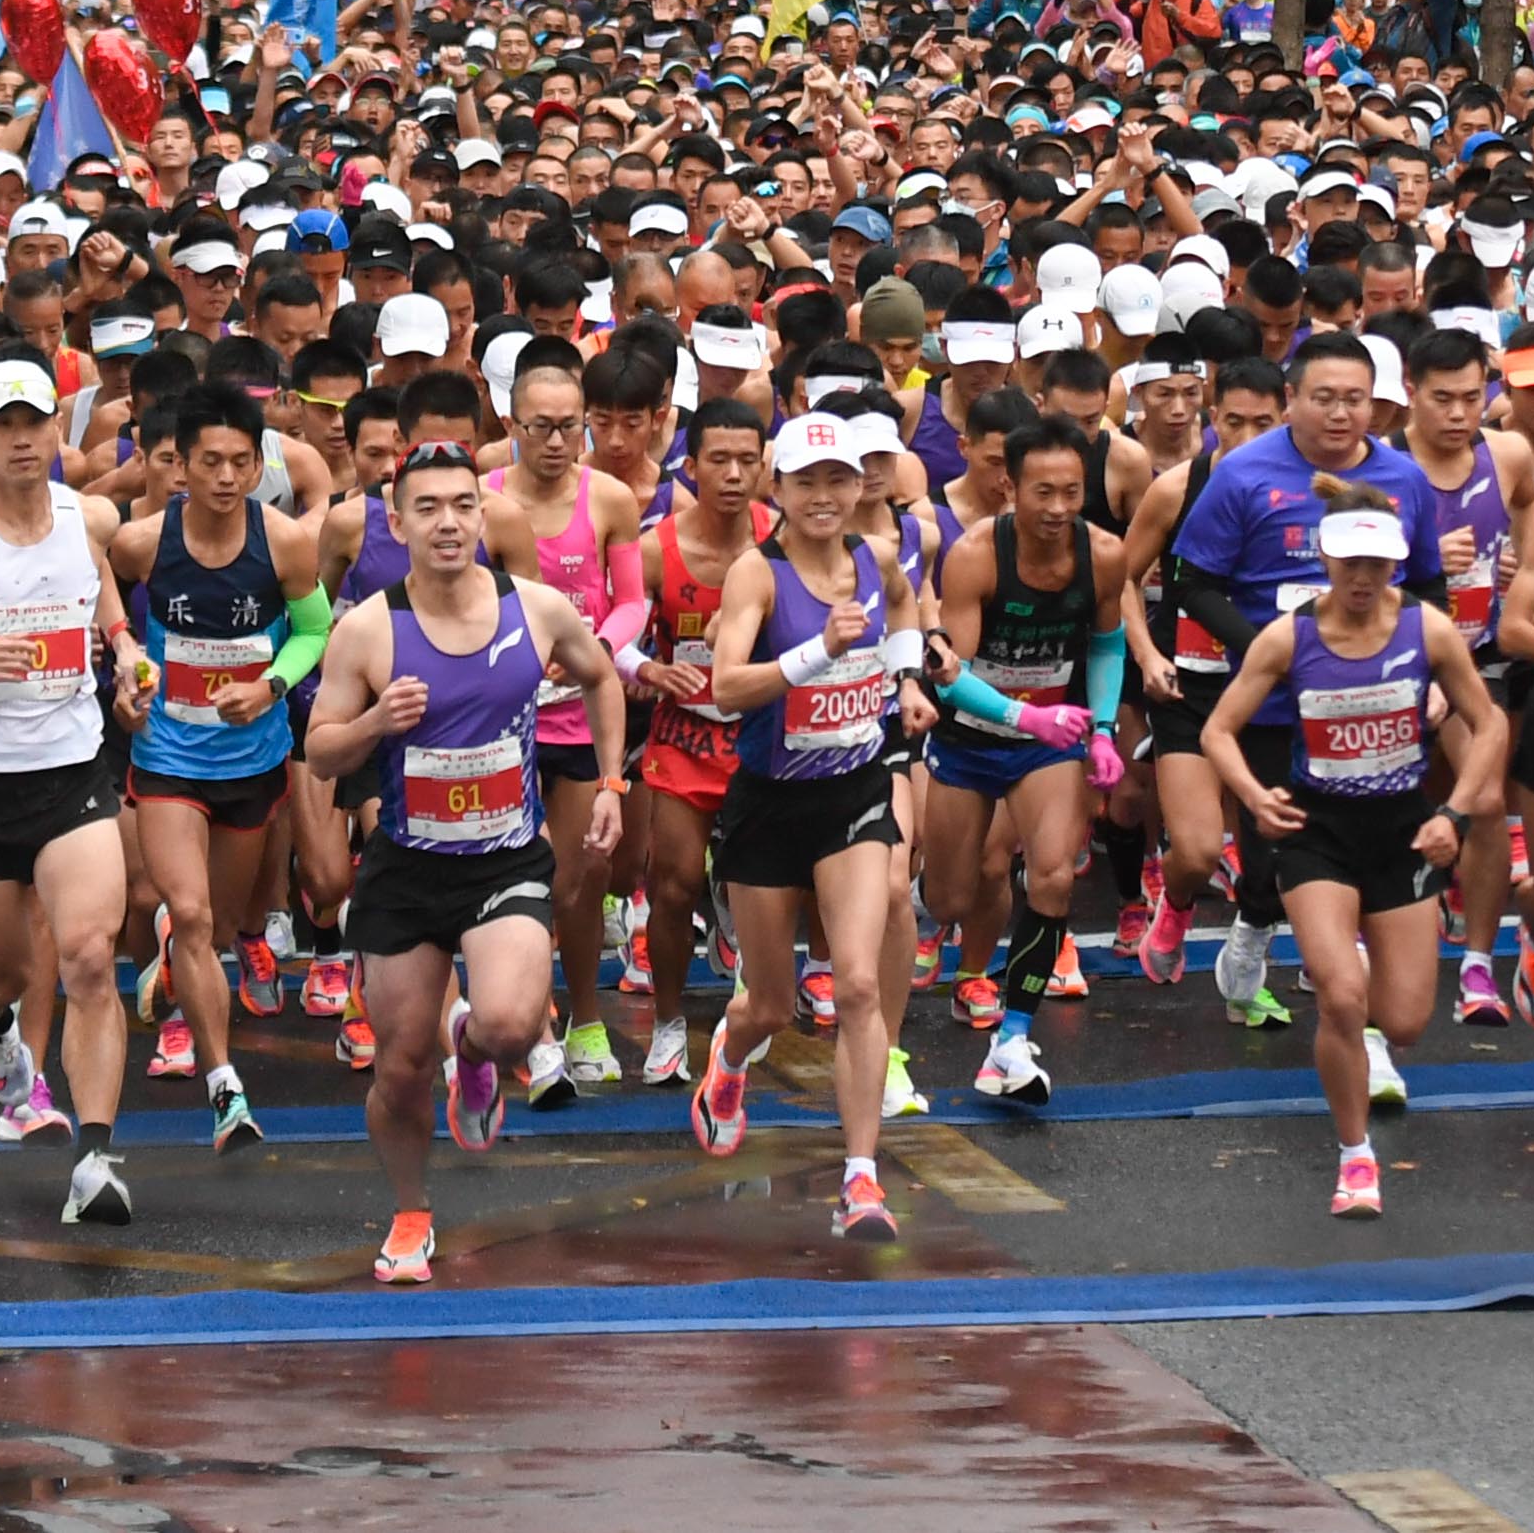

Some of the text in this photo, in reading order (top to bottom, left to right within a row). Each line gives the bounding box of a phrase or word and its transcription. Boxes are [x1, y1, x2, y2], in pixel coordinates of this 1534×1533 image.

[167, 593, 262, 627] 乐清
[809, 681, 882, 724] 20006
[1326, 715, 1414, 752] 20056
[447, 783, 485, 814] 61
